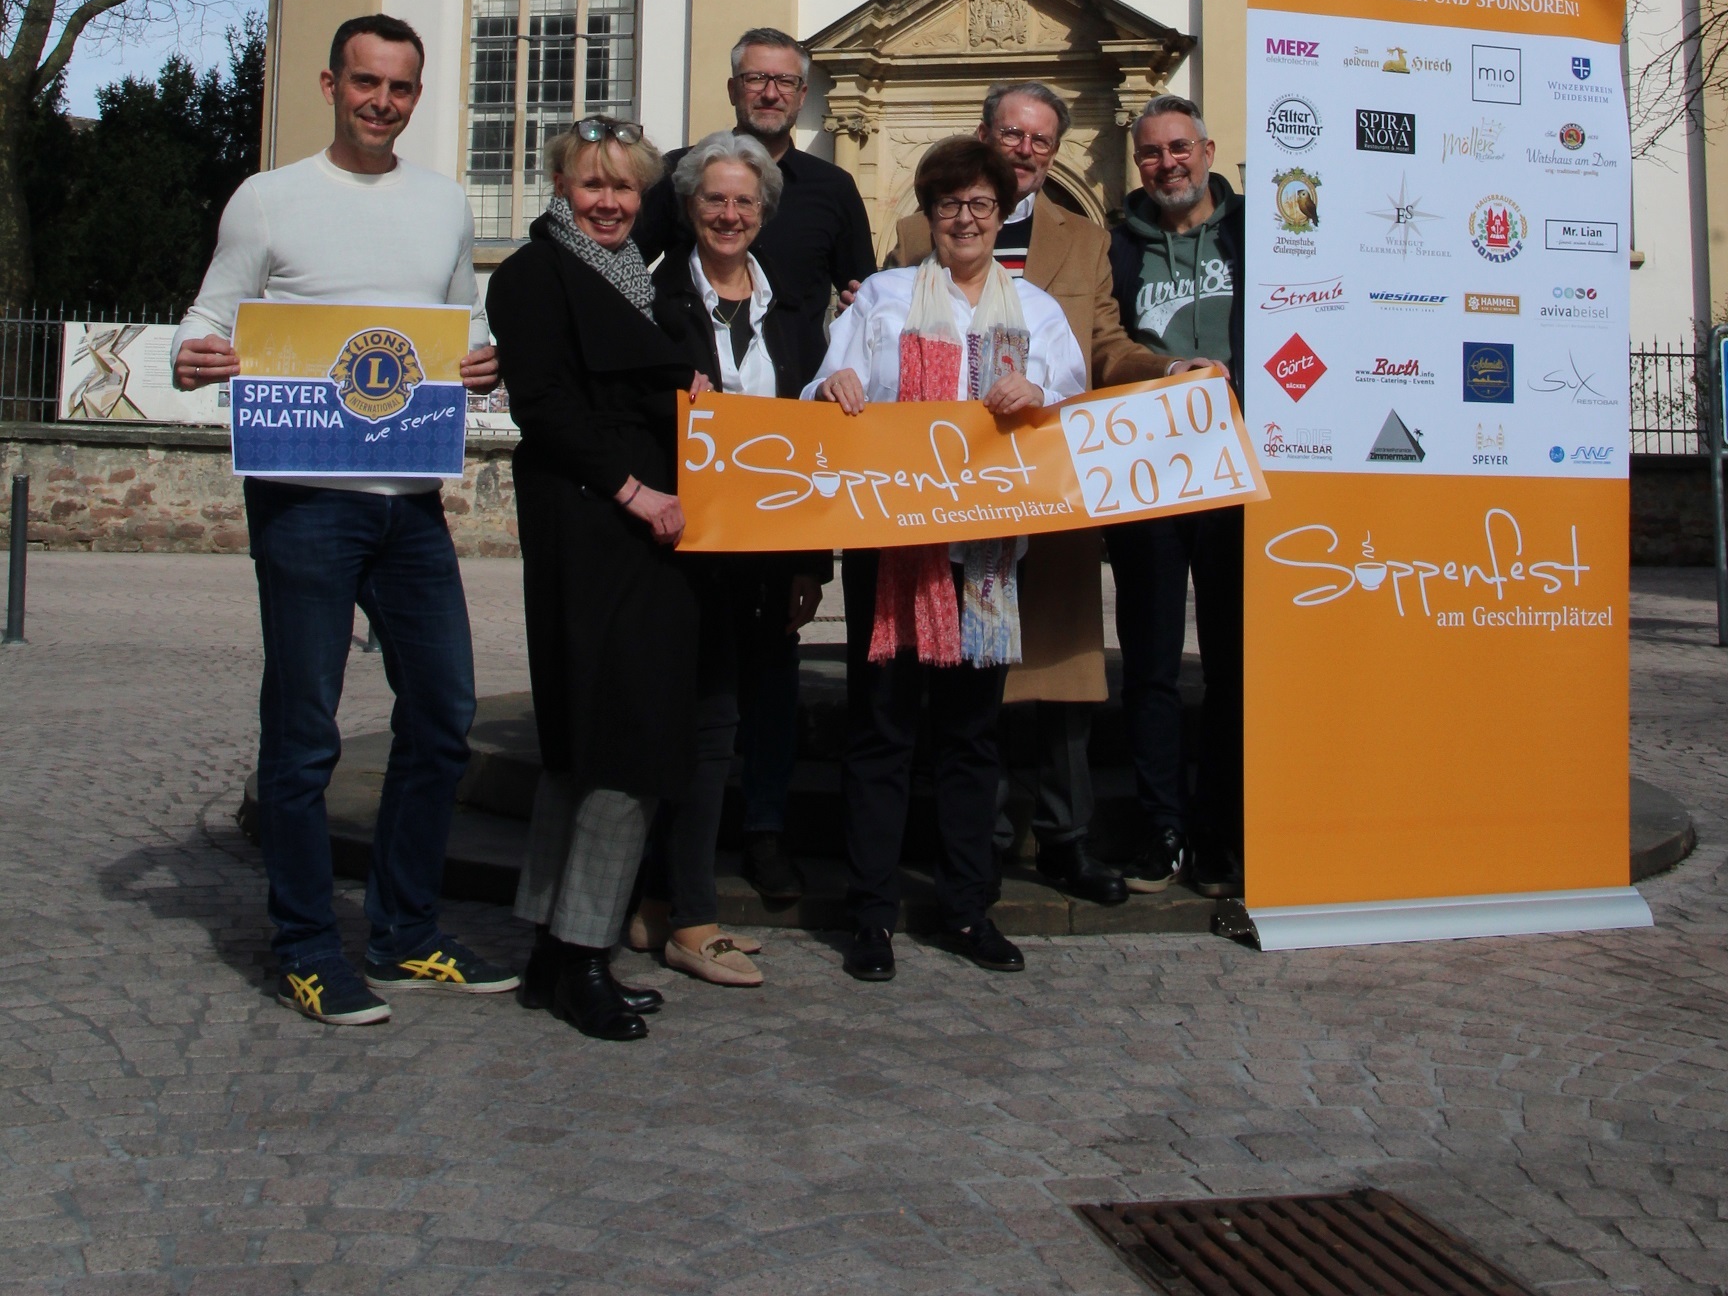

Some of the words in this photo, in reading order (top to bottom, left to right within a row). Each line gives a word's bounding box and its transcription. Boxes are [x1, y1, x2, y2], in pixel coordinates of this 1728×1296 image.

[1266, 38, 1320, 58] MERZ
[1266, 56, 1319, 66] elektrotechnik
[1343, 57, 1380, 68] goldenen
[1411, 57, 1452, 74] Hirsch
[1479, 67, 1515, 83] mio
[1278, 109, 1311, 123] Alter
[1360, 112, 1411, 131] SPIRA
[1365, 128, 1409, 146] NOVA
[1442, 126, 1494, 164] Möllers
[1526, 148, 1572, 165] Wirtshaus
[1575, 157, 1589, 166] am
[1592, 152, 1617, 167] Dom
[1475, 194, 1521, 213] HAUSBRAUEREI
[1562, 226, 1578, 236] Mr.
[1581, 226, 1602, 237] Lian
[1471, 237, 1523, 263] DOMHOF
[1260, 281, 1343, 310] Straub
[1481, 297, 1516, 308] HAMMEL
[1315, 305, 1344, 313] CATERING
[1540, 305, 1608, 319] avivabeisel
[353, 333, 406, 353] LIONS
[366, 357, 390, 388] L
[1277, 356, 1314, 378] Görtz
[1381, 377, 1407, 385] Catering
[244, 384, 328, 404] SPEYER
[349, 396, 400, 413] INTERNATIONAL
[239, 408, 344, 429] PALATINA
[365, 425, 391, 442] we
[400, 405, 456, 431] serve
[1068, 386, 1228, 455] 26.10.
[685, 410, 725, 472] 5.
[1297, 428, 1332, 446] DIE
[1264, 444, 1332, 454] COCKTAILBAR
[1473, 455, 1508, 465] SPEYER
[1085, 446, 1247, 514] 2024
[897, 512, 927, 527] am
[931, 497, 1075, 524] Geschirrplätzel
[1437, 609, 1465, 627] am
[1472, 606, 1613, 631] Geschirrplätzel
